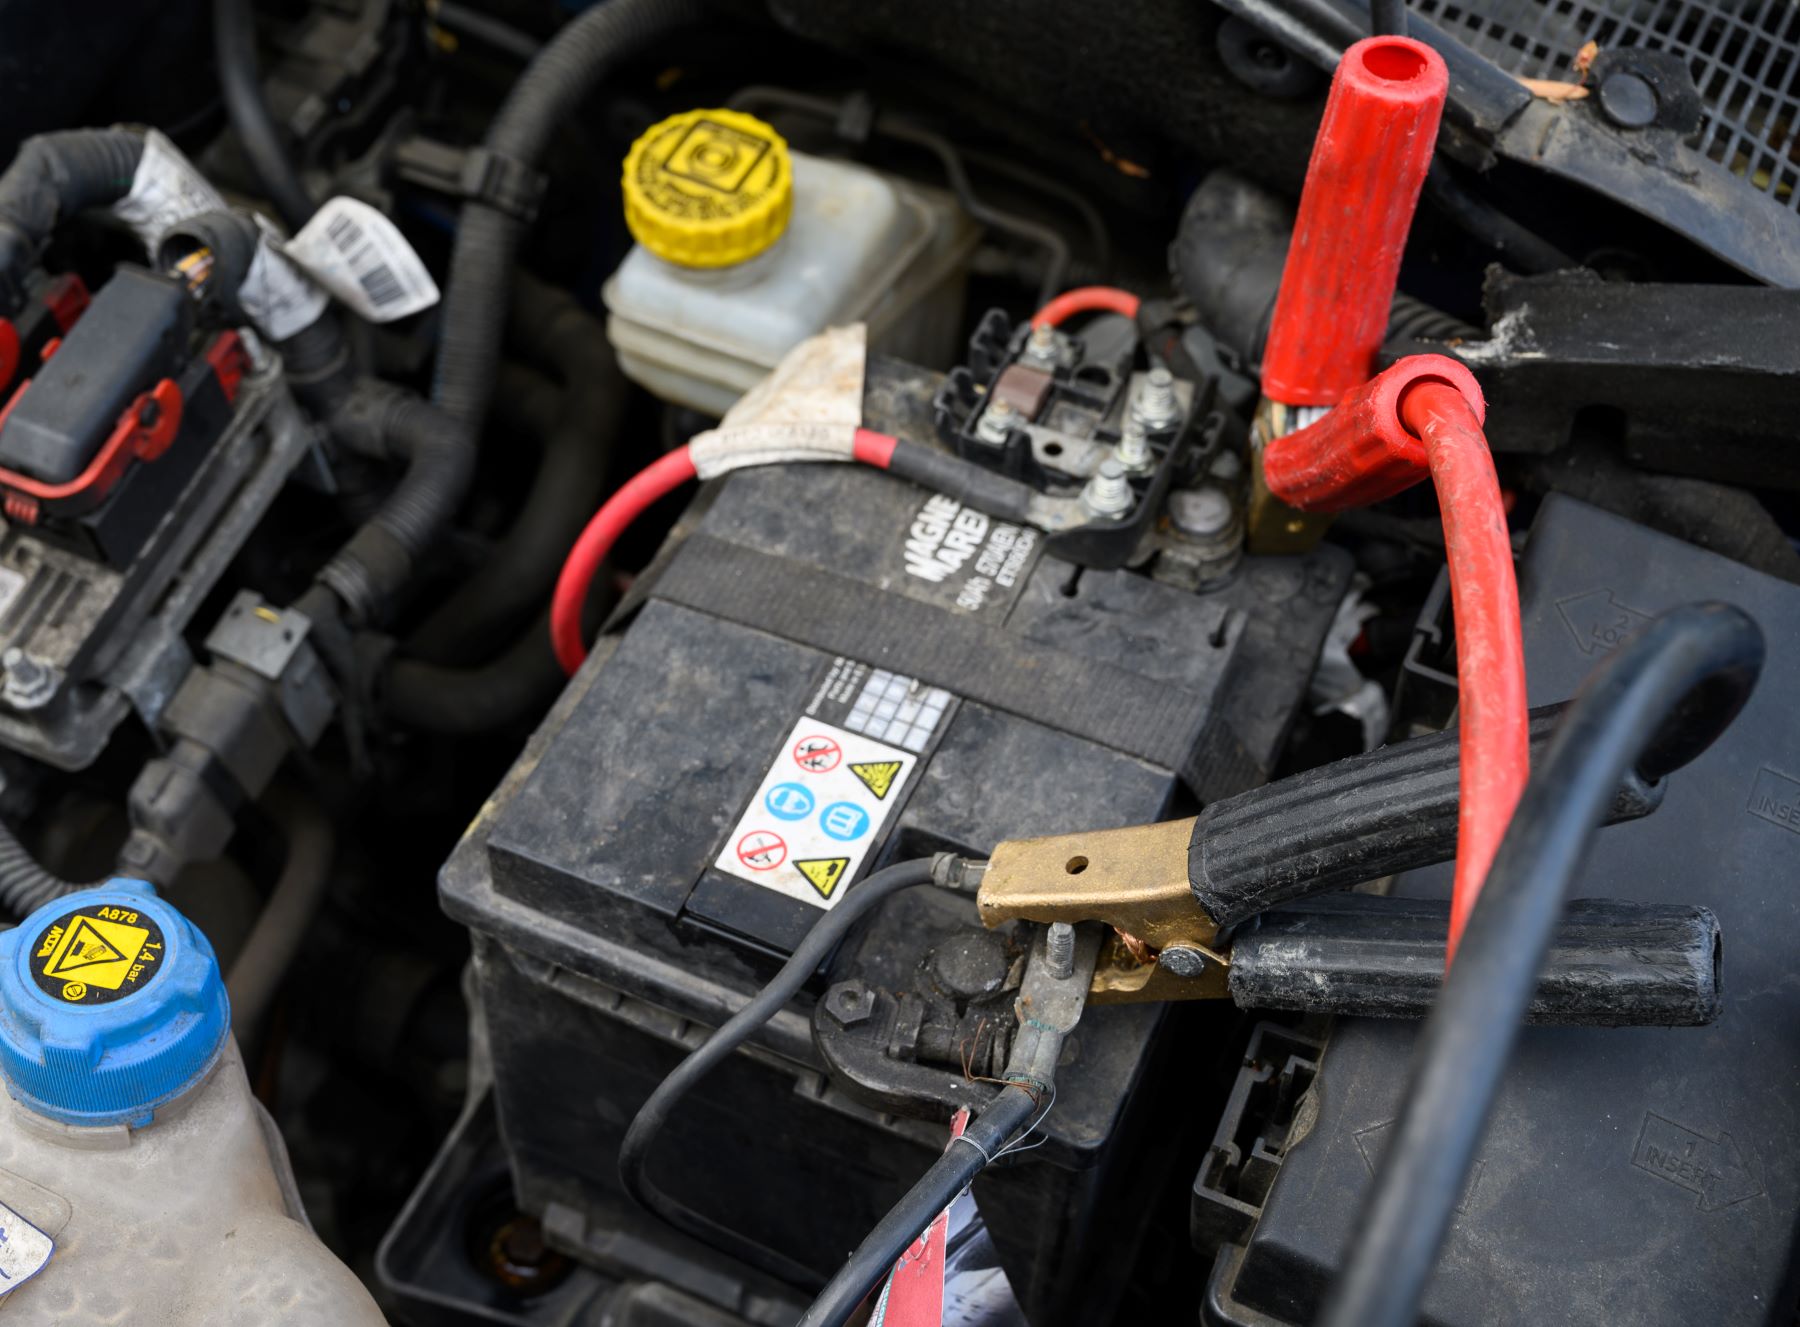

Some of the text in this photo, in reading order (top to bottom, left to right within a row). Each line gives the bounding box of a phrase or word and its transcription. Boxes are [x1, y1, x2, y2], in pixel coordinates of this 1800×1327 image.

[98, 906, 138, 924] A878
[127, 942, 162, 983] 1.4 bar
[1646, 1145, 1724, 1191] INSERT
